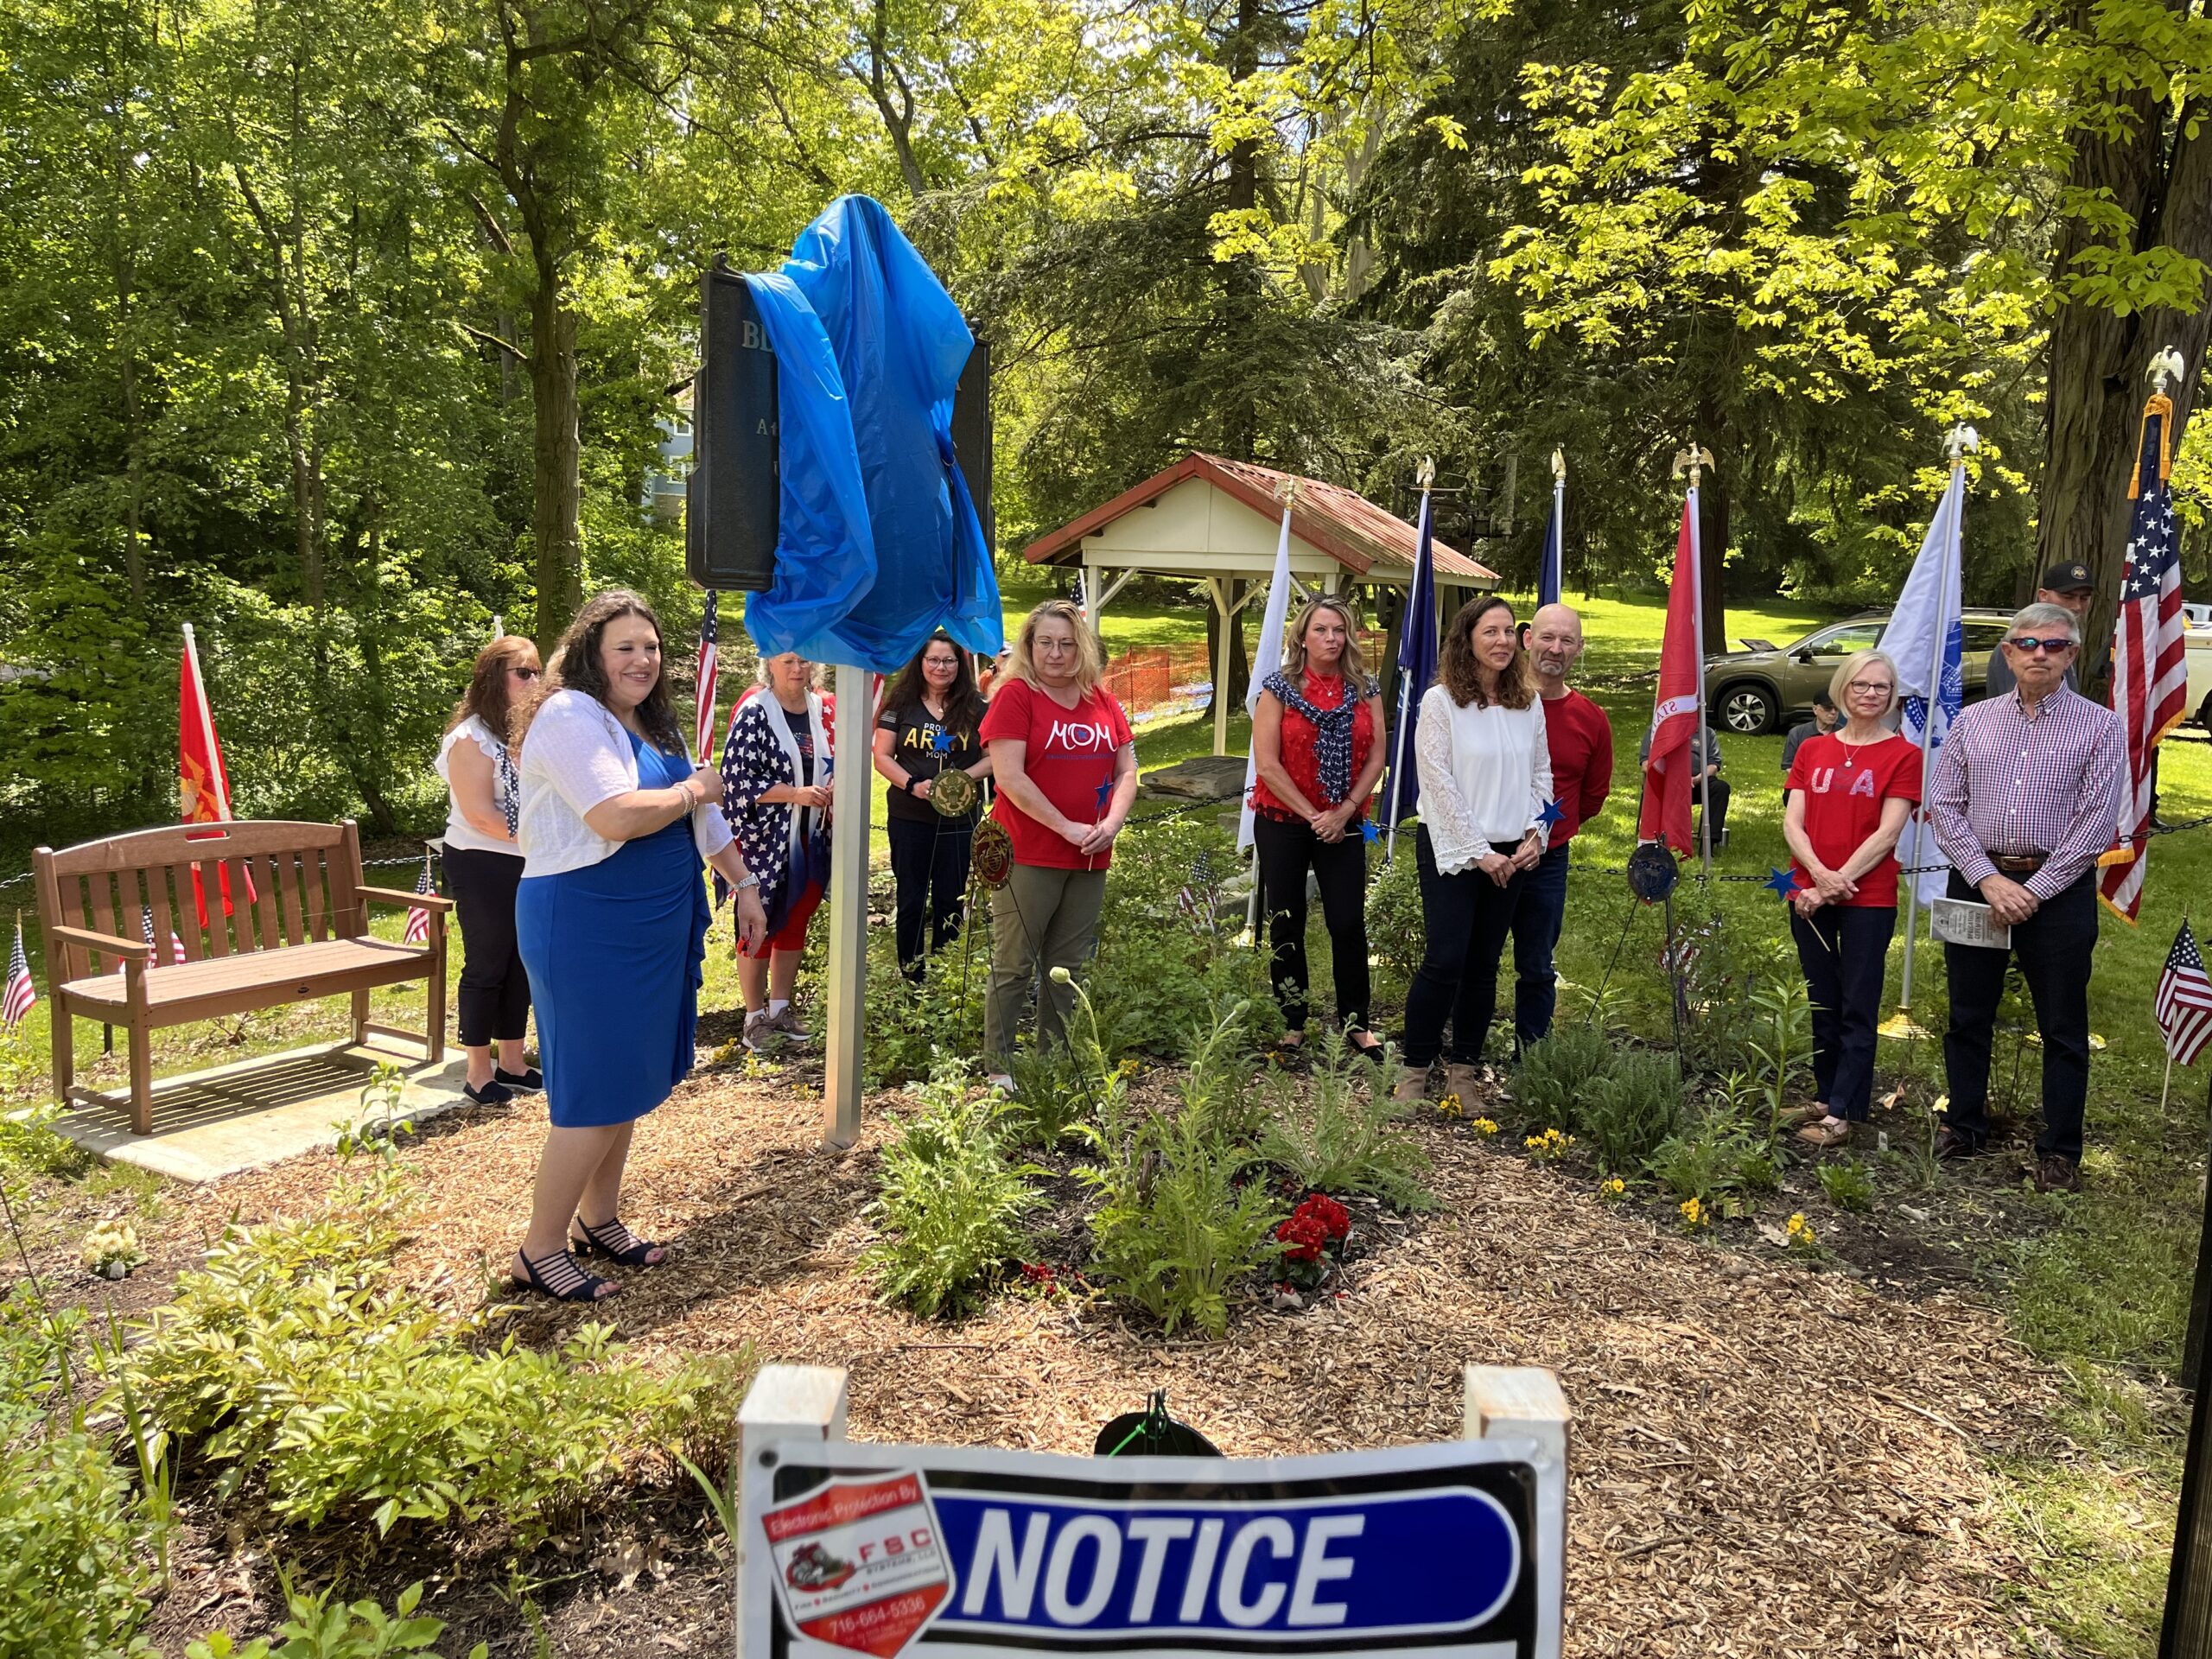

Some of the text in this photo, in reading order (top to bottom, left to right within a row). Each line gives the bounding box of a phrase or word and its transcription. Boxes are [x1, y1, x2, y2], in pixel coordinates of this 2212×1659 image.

[904, 728, 969, 751] ARY
[924, 722, 948, 732] PROU
[1045, 720, 1117, 753] MOM
[925, 751, 948, 760] MOM
[770, 1483, 917, 1536] Electronic Protection By
[963, 1508, 1365, 1627] NOTICE
[830, 1595, 925, 1637] 716-664-5336
